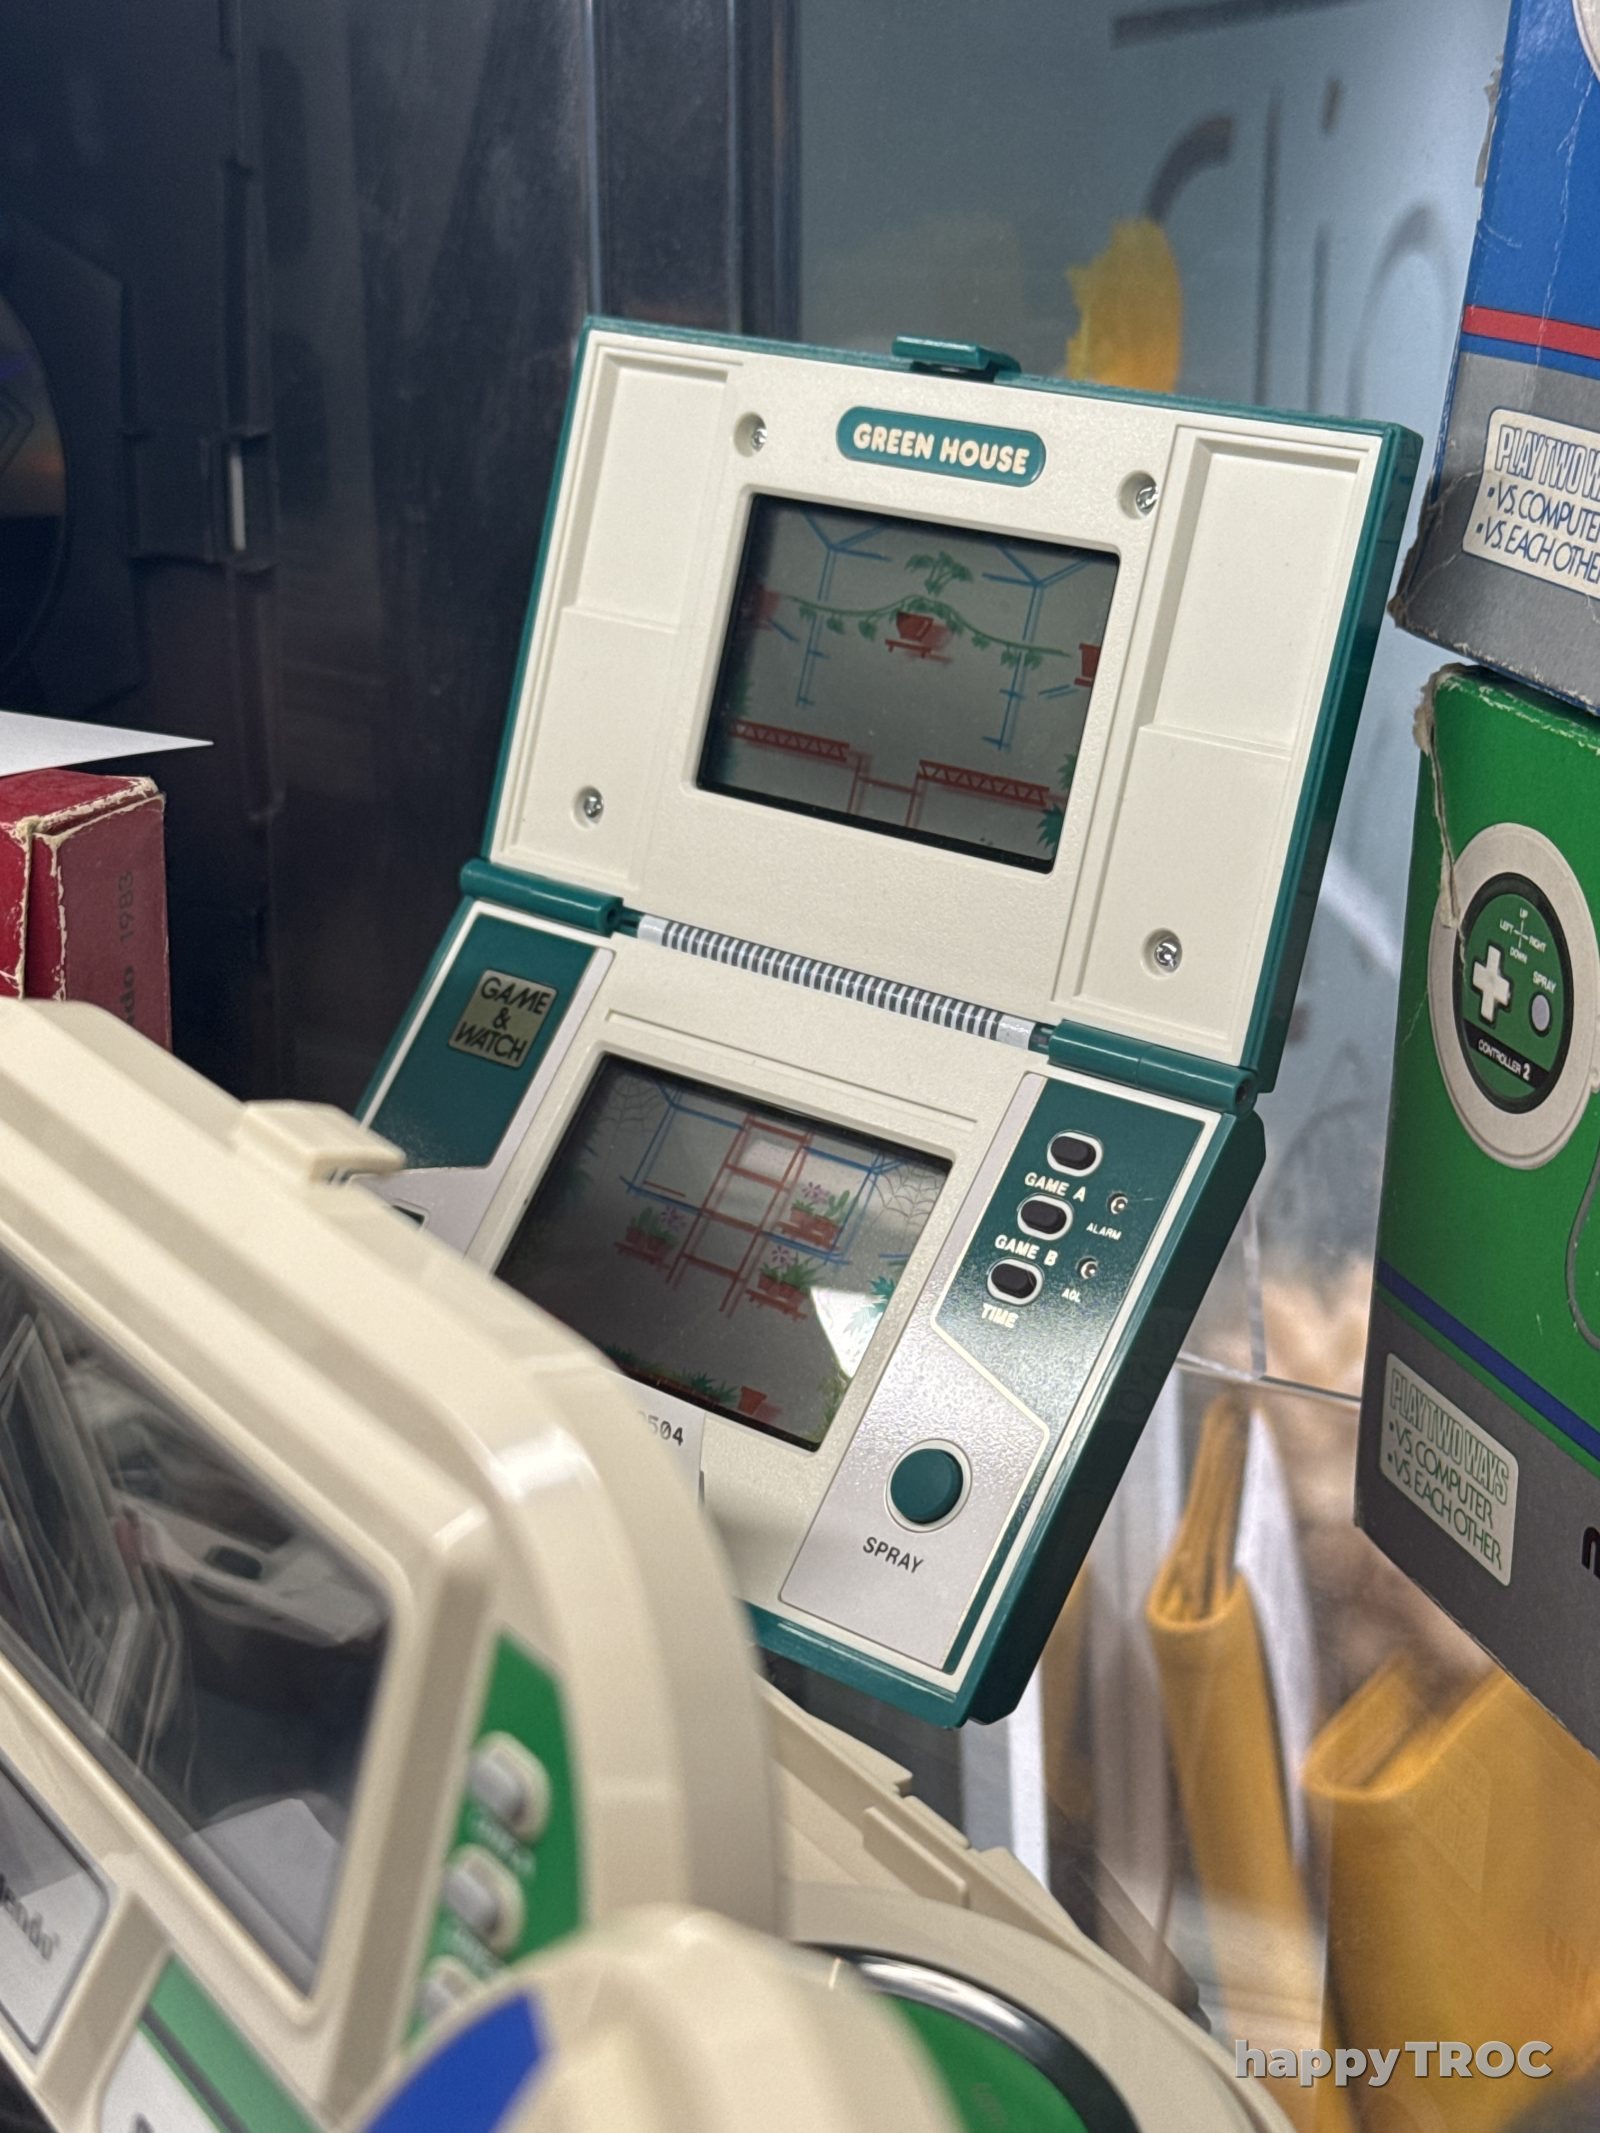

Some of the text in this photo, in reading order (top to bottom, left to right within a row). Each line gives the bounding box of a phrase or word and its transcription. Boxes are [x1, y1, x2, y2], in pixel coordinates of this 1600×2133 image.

[853, 422, 1030, 475] GREEN HOUSE
[1495, 424, 1546, 480] PLAY
[1539, 436, 1586, 495] TWO
[1505, 525, 1556, 566] EACH
[1500, 918, 1514, 935] LEFT
[1509, 946, 1528, 965] DOWN
[481, 977, 550, 1015] GAME
[1533, 970, 1557, 994] SPRAY
[492, 1007, 511, 1030] &
[454, 1022, 528, 1062] WATCH
[1478, 1039, 1531, 1081] CONTROLLER 2
[1024, 1172, 1087, 1202] GAME A
[994, 1234, 1058, 1266] GAME B
[1086, 1222, 1122, 1240] ALARM
[981, 1303, 1019, 1329] TIME
[1390, 1368, 1509, 1505] PLAY TWO WAYS
[1415, 1441, 1493, 1529] COMPUTER
[1414, 1473, 1451, 1523] EACH
[1453, 1507, 1503, 1571] OTHER
[863, 1536, 924, 1574] SPRAY
